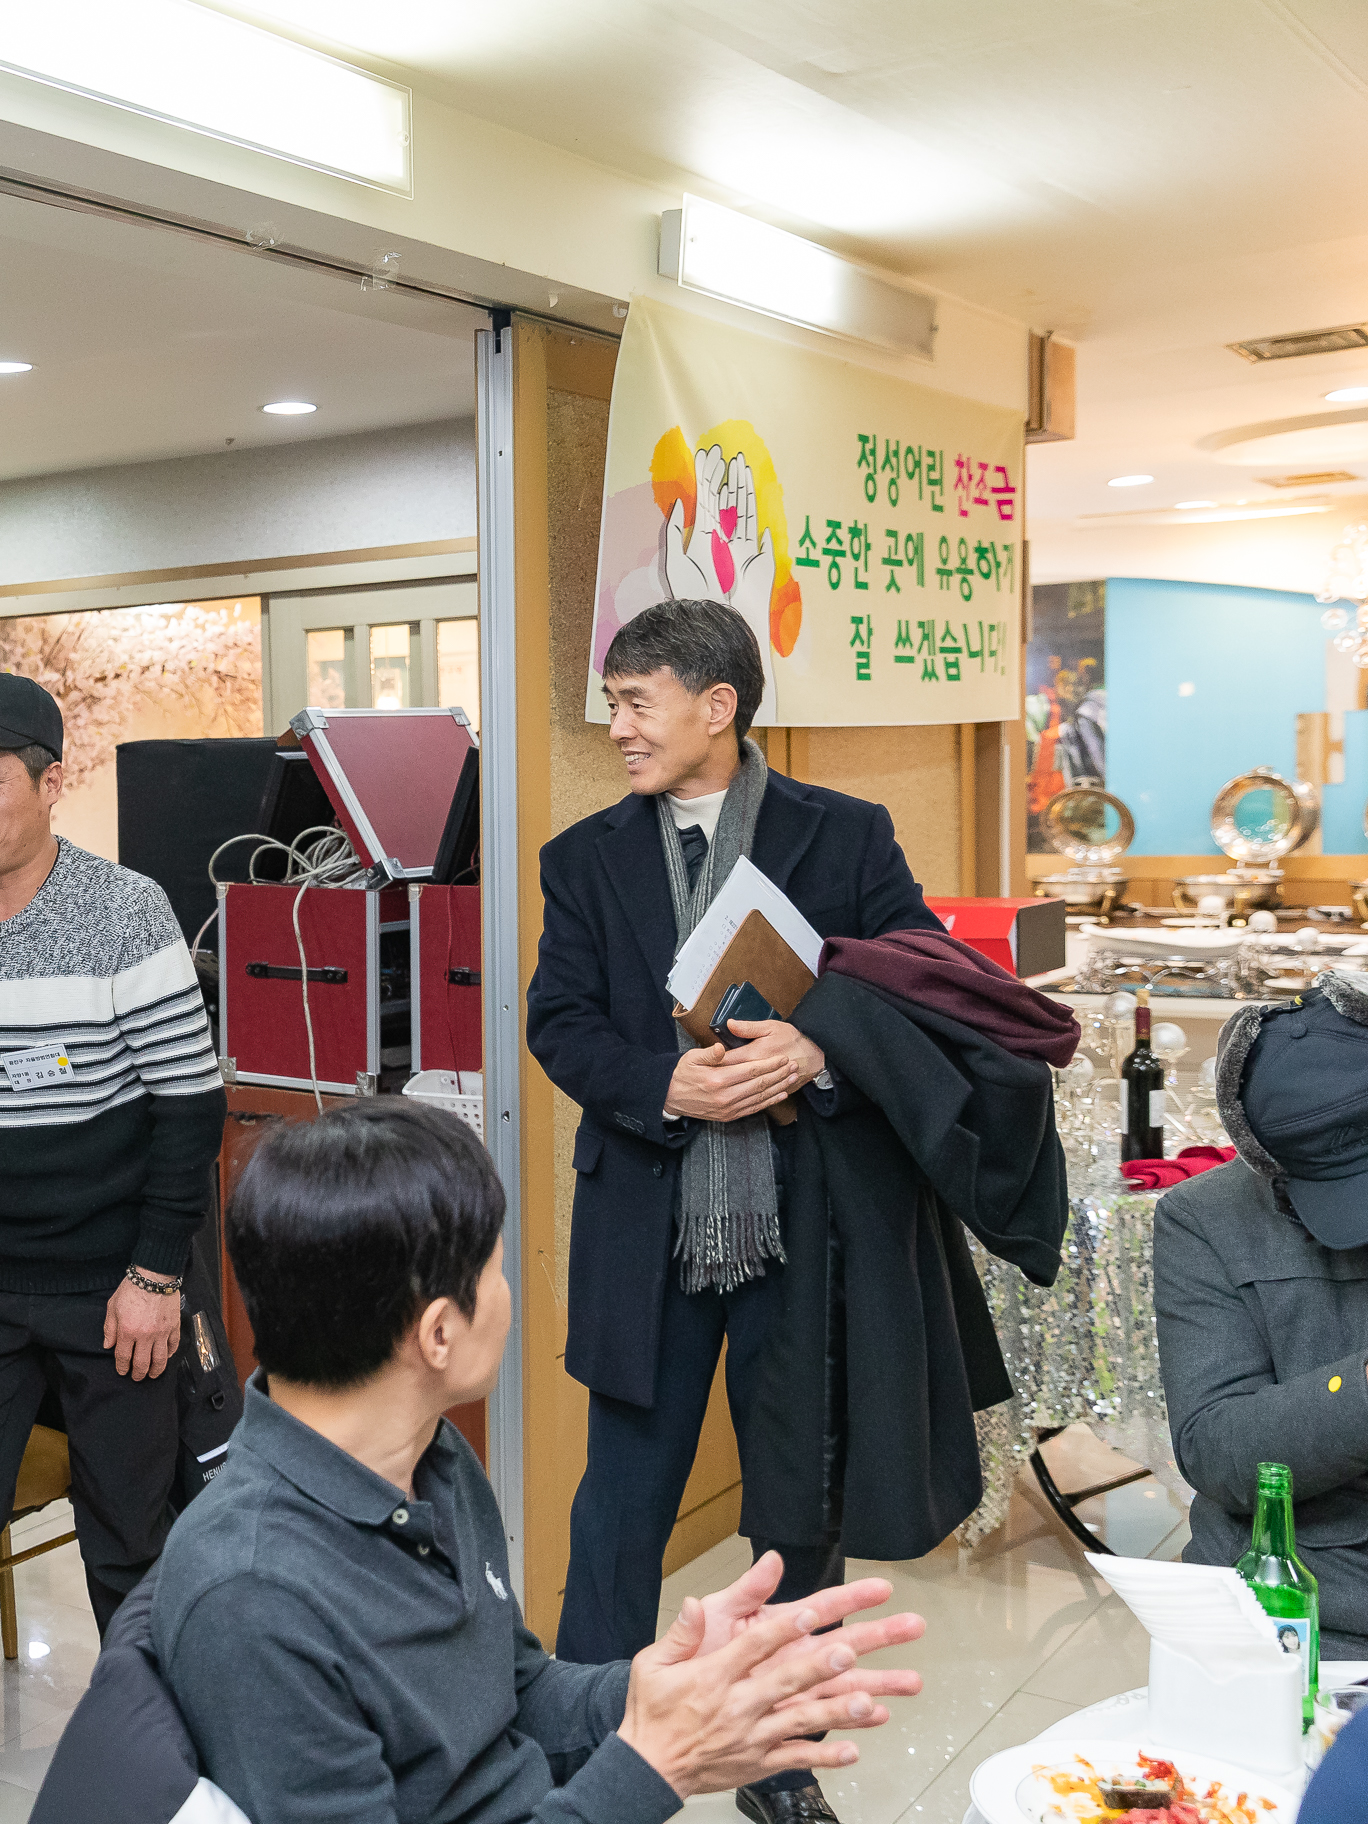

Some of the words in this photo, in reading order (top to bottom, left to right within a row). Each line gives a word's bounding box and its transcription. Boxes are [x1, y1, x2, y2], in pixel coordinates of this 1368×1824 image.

[857, 433, 944, 513] 정성어린
[954, 453, 1017, 521] 찬조금
[795, 514, 872, 591] 소중한
[881, 528, 925, 594] 곳에
[935, 535, 1016, 602] 유용하게
[849, 614, 874, 681] 잘
[894, 620, 1008, 682] 쓰겠습니다!
